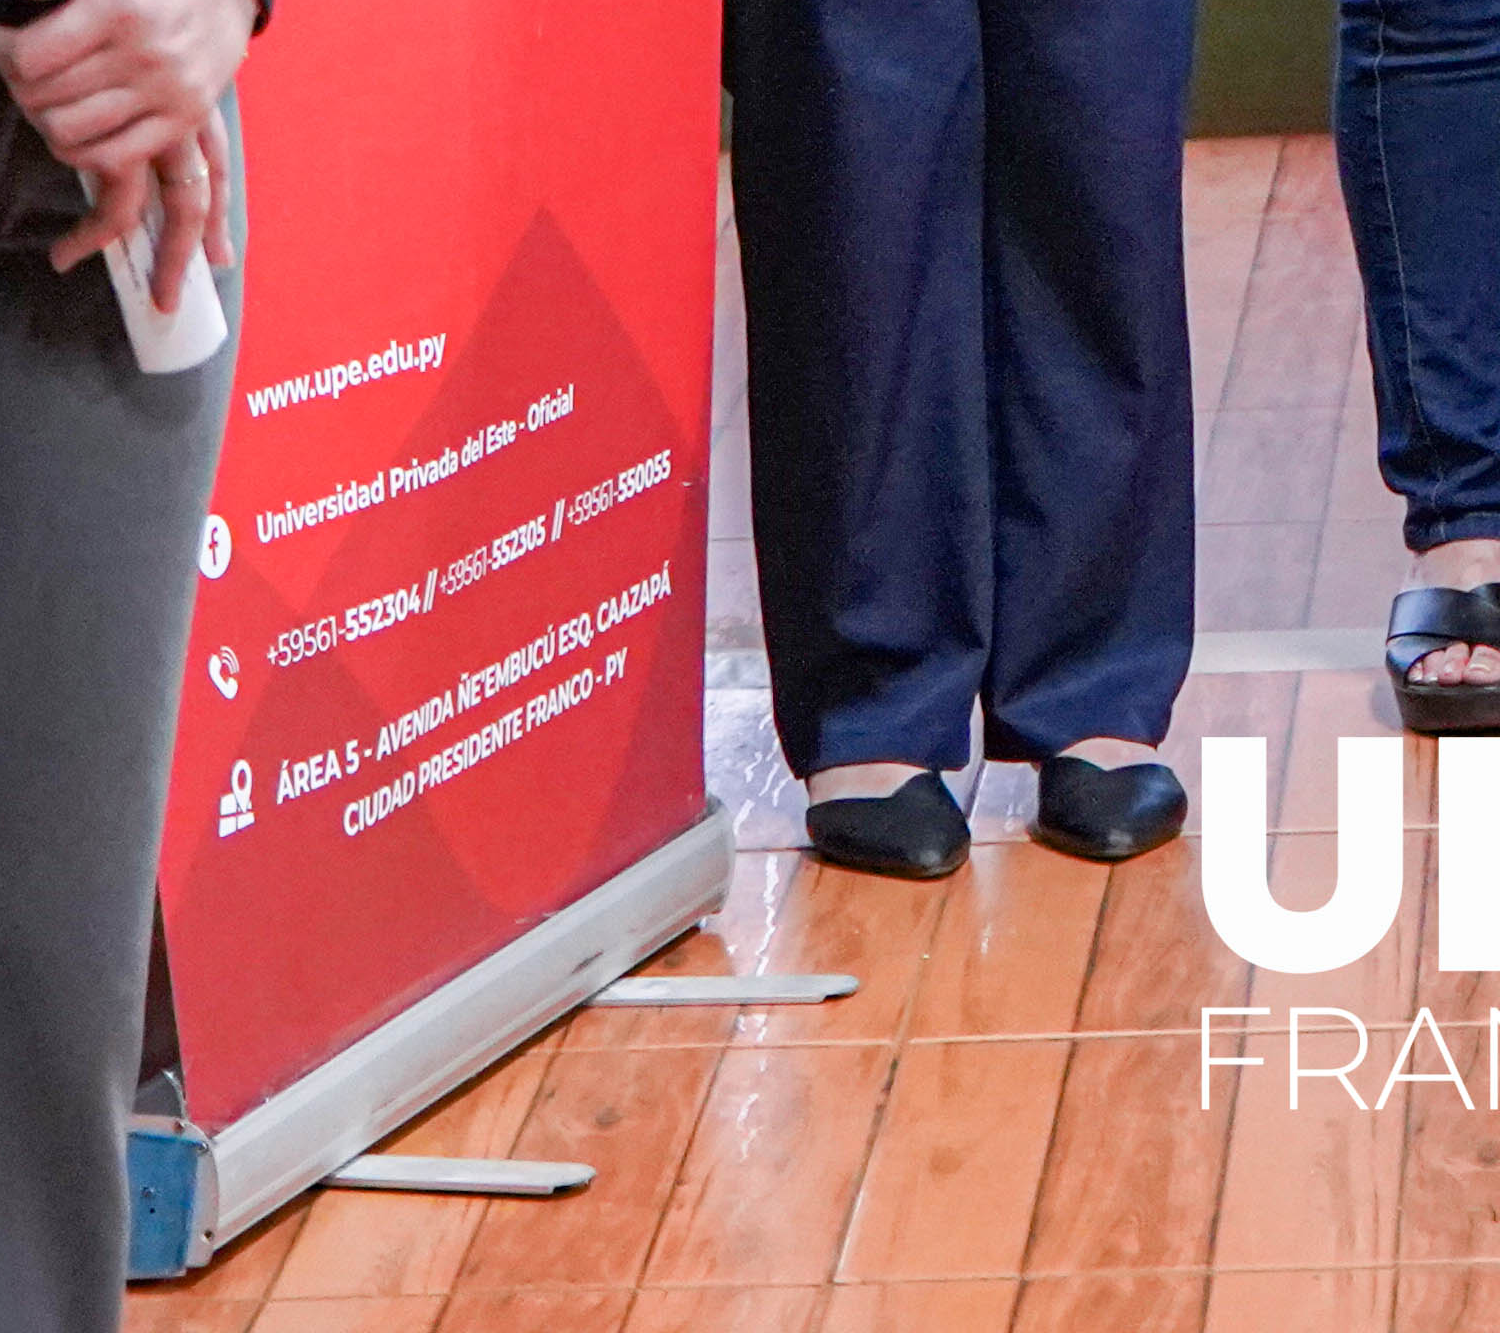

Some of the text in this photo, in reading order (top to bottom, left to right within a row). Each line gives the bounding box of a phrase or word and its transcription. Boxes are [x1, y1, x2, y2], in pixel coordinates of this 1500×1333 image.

[246, 333, 447, 418] www.upe.edu.py
[256, 470, 385, 545] Universidad
[389, 447, 459, 499] Privada
[461, 430, 485, 468] del
[486, 419, 517, 456] Este
[527, 383, 575, 433] Oficial
[266, 583, 422, 668] +59561-552304
[439, 514, 547, 595] +59561-552305
[566, 448, 672, 527] +59561-550055
[276, 759, 342, 805] ÁREA
[344, 740, 360, 775] 5
[376, 689, 455, 762] AVENIDA
[595, 560, 672, 633] CAAZAPÁ
[342, 772, 416, 837] CIUDAD
[417, 706, 524, 796] PRESIDENTE
[525, 667, 595, 734] FRANCO
[604, 647, 629, 687] PY
